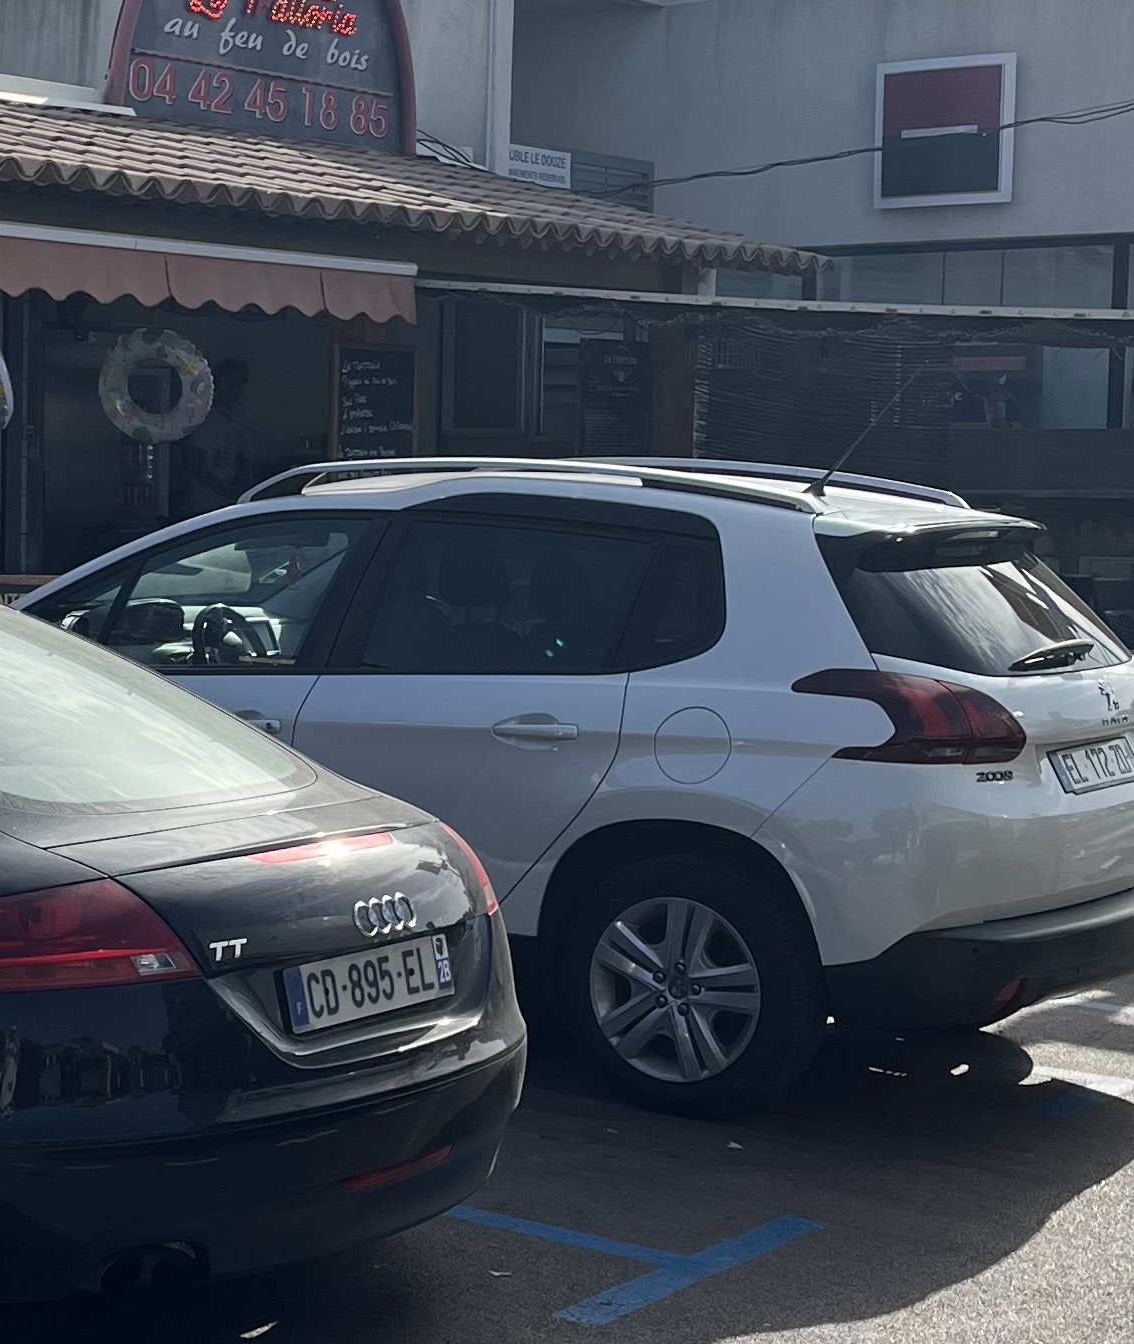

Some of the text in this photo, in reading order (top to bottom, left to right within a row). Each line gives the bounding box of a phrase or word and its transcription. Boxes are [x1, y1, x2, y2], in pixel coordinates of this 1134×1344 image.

[164, 17, 369, 71] au feu de bois
[129, 57, 389, 138] 04 42 45 18 85
[976, 770, 1014, 783] 2008
[209, 937, 248, 962] TT
[306, 947, 435, 1019] CD-895-EL
[437, 959, 452, 984] 2B
